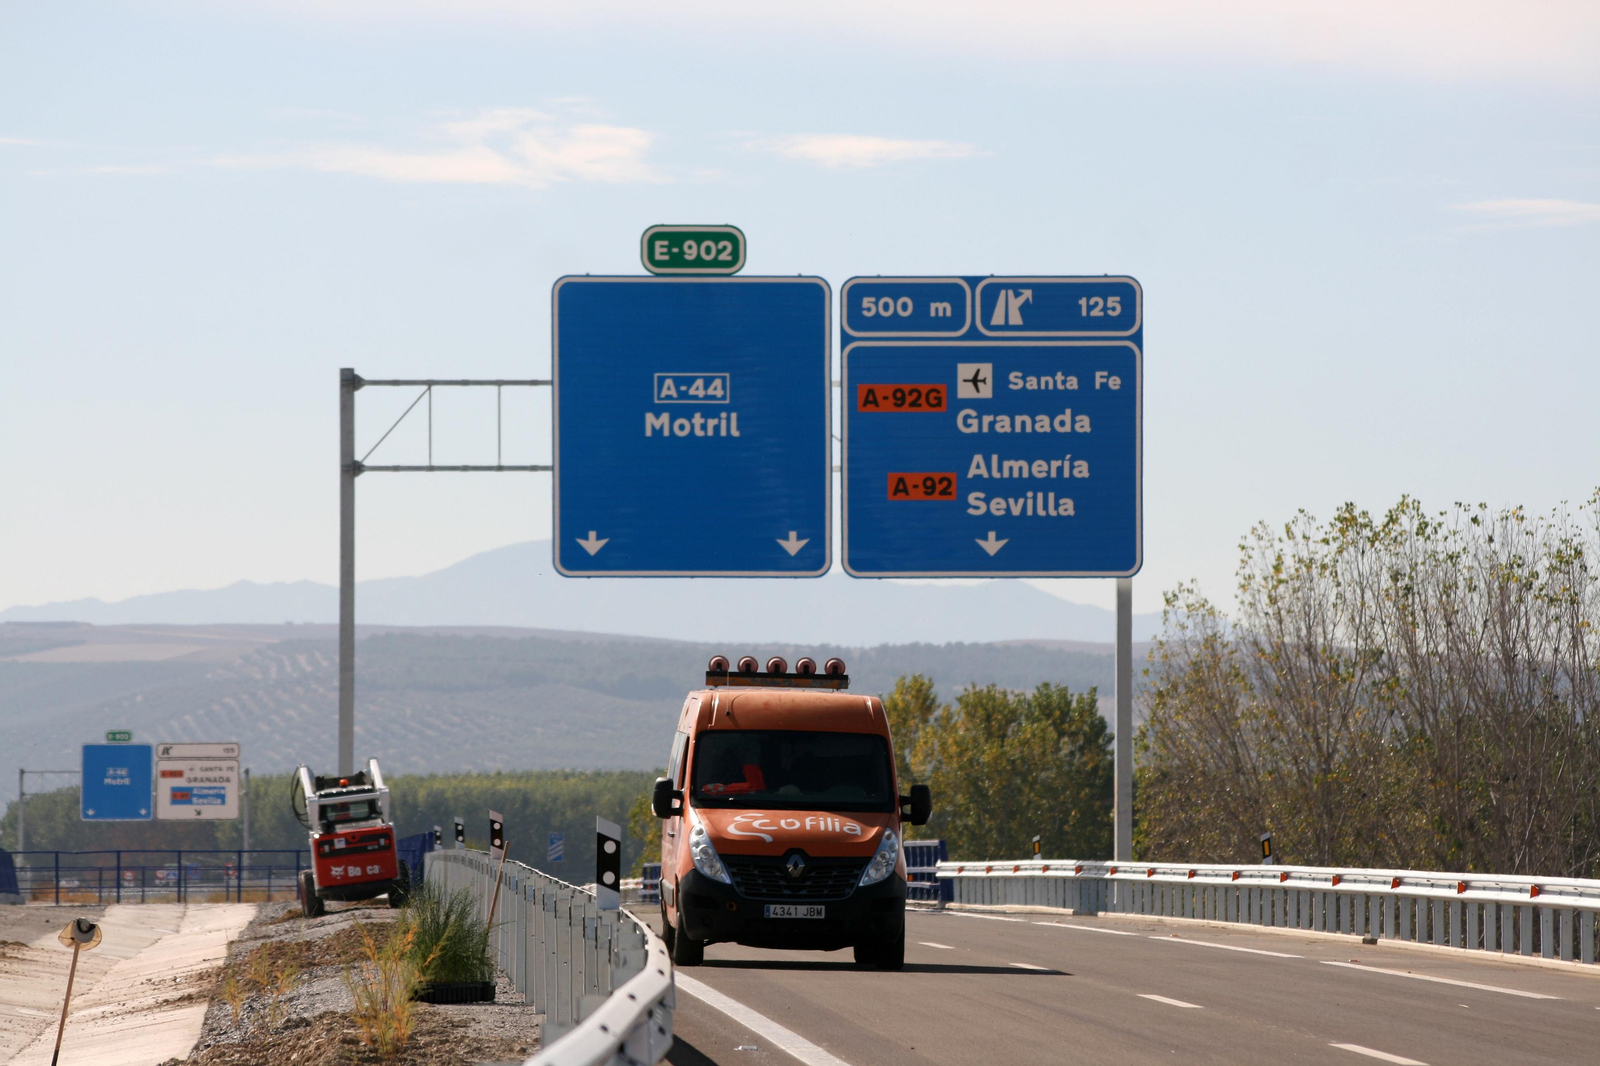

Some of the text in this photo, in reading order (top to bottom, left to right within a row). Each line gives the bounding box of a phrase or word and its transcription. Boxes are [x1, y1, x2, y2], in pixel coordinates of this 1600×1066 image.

[654, 240, 733, 261] E-902
[861, 297, 951, 317] 500 m
[1078, 296, 1122, 317] 125
[660, 378, 724, 398] A-44
[1008, 371, 1122, 390] Santa Fe
[862, 388, 943, 408] A-92G
[645, 412, 740, 437] Motril
[956, 408, 1092, 433] Granada
[966, 454, 1090, 479] Almería
[892, 477, 953, 497] A-92
[966, 492, 1075, 516] Sevilla
[727, 813, 862, 843] Ecofilia
[772, 906, 823, 917] 4341 JBM
